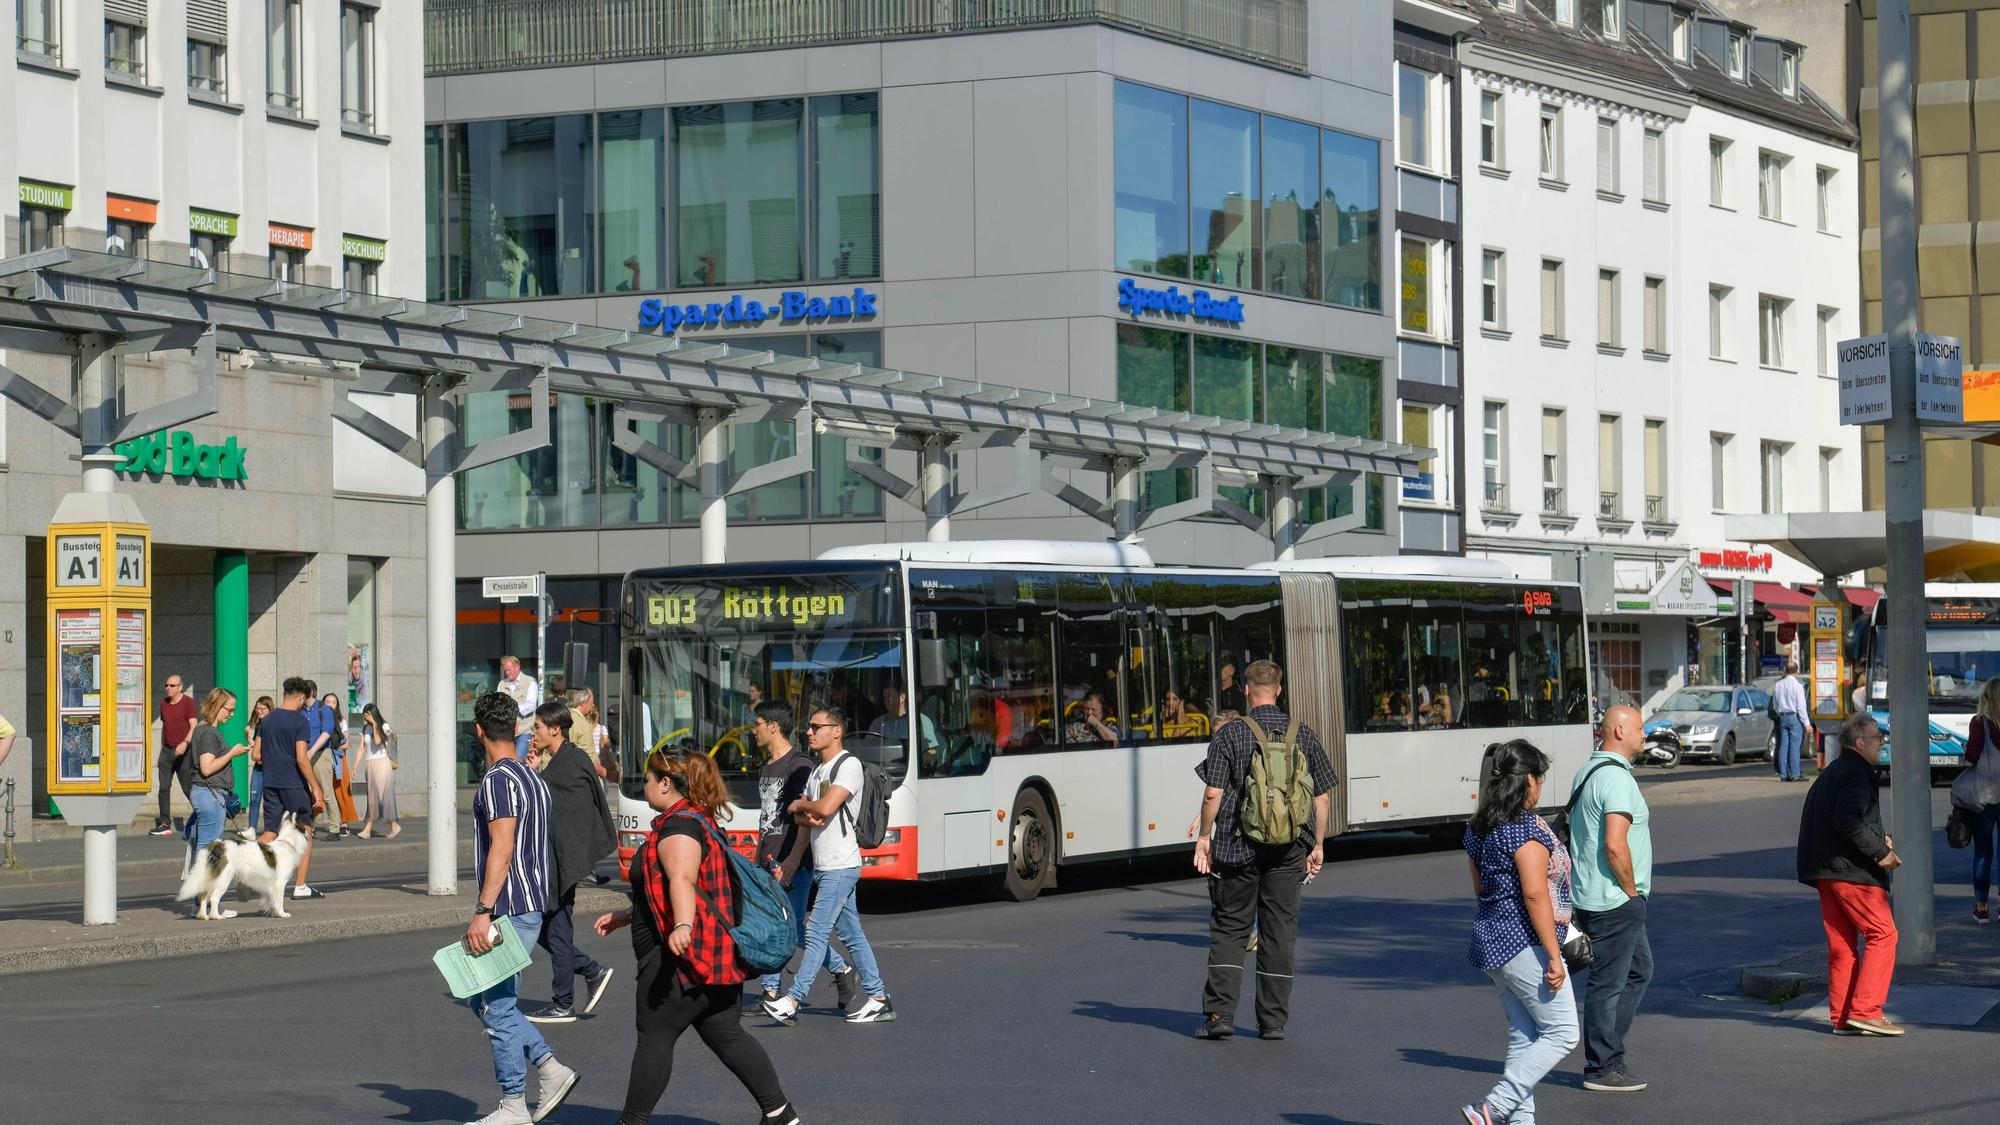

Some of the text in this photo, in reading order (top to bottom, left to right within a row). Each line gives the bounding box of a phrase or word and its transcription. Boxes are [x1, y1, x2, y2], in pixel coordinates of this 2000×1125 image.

[19, 185, 64, 207] STUDIUM
[190, 214, 229, 234] SPRACHE
[269, 228, 305, 248] THERAPIE
[342, 240, 384, 260] ORSCHUNG
[1118, 278, 1246, 322] Sparda-Bank
[639, 288, 878, 333] Sparda-Bank
[1840, 342, 1887, 363] VORSICHT
[1918, 341, 1960, 361] VORSICHT
[171, 431, 249, 480] Bank
[63, 542, 101, 552] Bussteig
[116, 542, 142, 553] Bussteig
[67, 557, 98, 580] A1
[118, 557, 139, 580] A1
[922, 580, 939, 588] MAN
[649, 586, 845, 625] 603 Röttgen
[1532, 592, 1552, 606] SWB
[5, 630, 13, 643] 12
